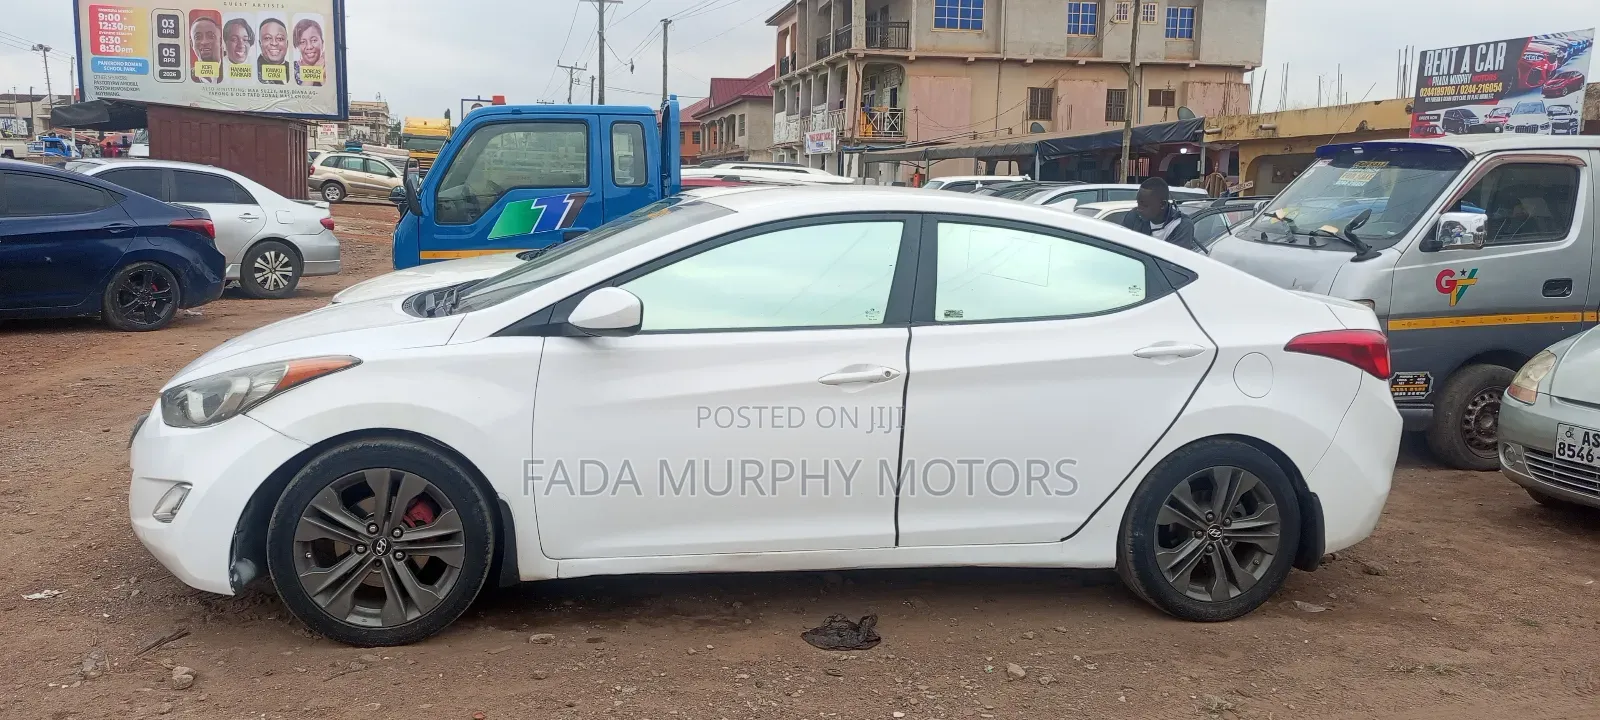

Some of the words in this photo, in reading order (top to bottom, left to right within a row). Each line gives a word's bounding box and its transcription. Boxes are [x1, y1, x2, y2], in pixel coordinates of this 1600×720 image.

[98, 13, 121, 21] 9:00
[162, 19, 175, 28] 03
[99, 36, 121, 44] 6:30
[163, 48, 176, 57] 05
[1424, 48, 1459, 76] RENT
[1460, 46, 1471, 73] A
[1474, 42, 1507, 72] CAR
[1460, 82, 1503, 94] 0244-216054
[1582, 431, 1600, 448] AS
